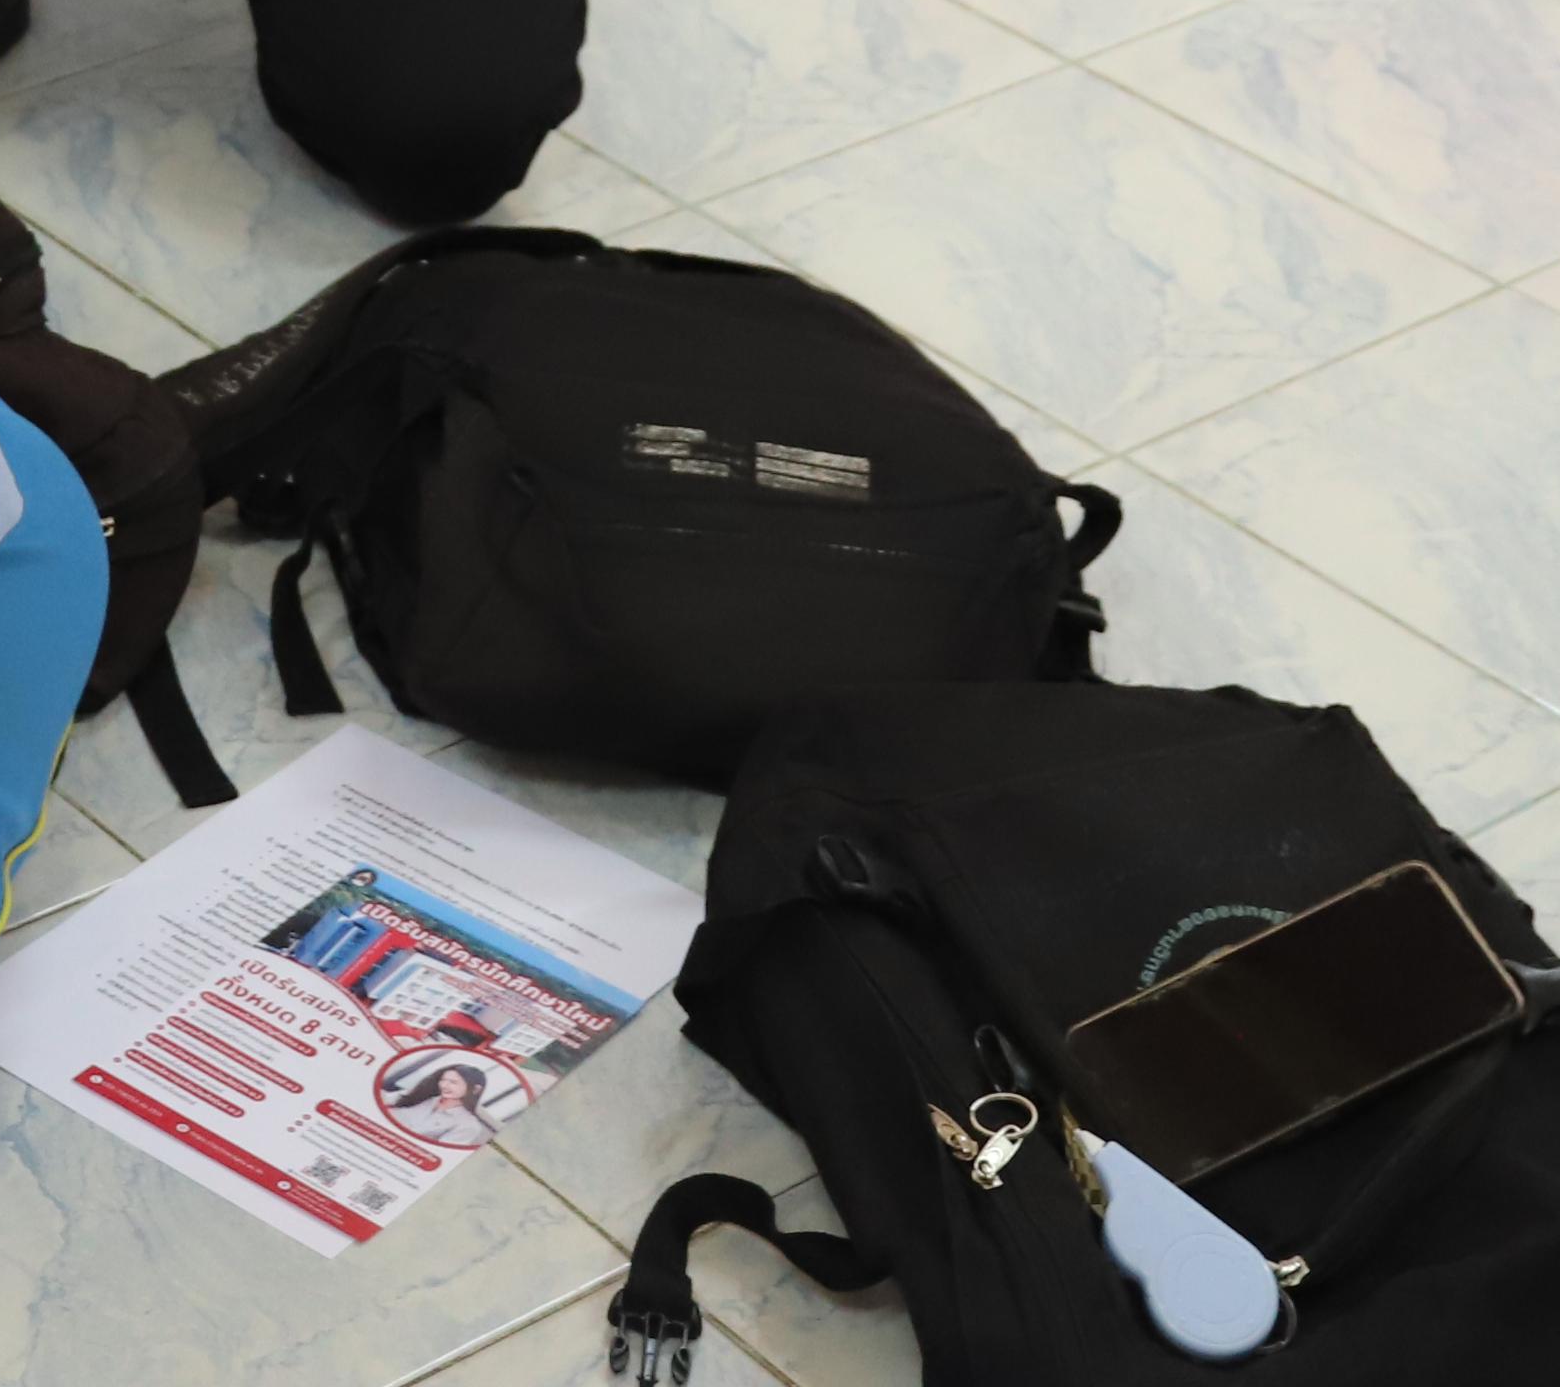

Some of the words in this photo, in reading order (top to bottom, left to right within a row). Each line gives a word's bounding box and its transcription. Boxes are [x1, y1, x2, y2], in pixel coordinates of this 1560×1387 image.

[239, 957, 363, 1028] เปิดรับสมัคร
[360, 900, 612, 1033] เปิดรับสมัครนักศึกษาใหม่
[215, 973, 300, 1024] ทั้งหมด
[300, 1018, 320, 1036] 8
[323, 1031, 378, 1067] สาขา
